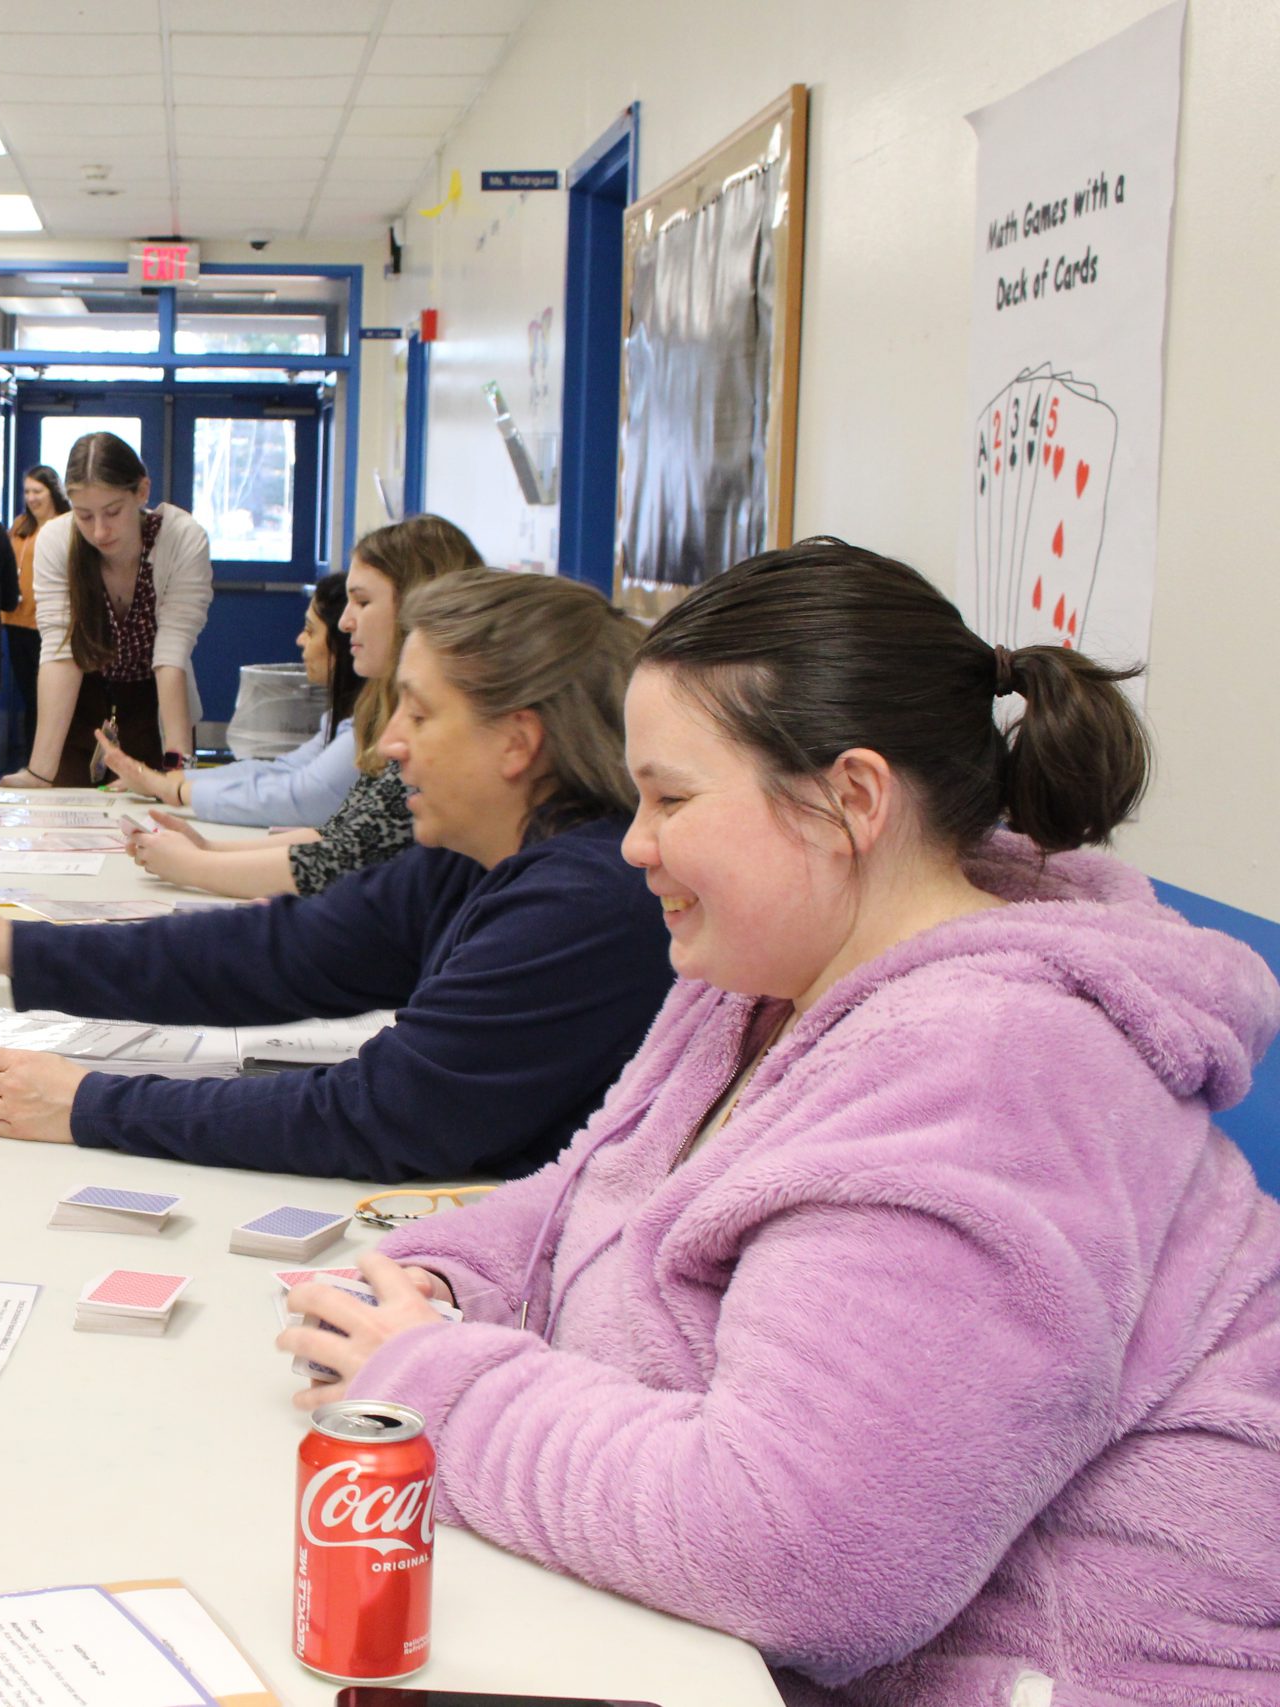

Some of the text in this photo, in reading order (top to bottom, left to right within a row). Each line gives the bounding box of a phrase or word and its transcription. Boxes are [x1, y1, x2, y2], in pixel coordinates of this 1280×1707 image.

[987, 171, 1124, 253] Math Games with a
[142, 246, 190, 281] EXIT
[996, 244, 1098, 311] Deck of Cards
[977, 393, 1059, 468] A 2 3 4 5
[371, 1554, 430, 1573] ORIGINAL
[296, 1544, 308, 1658] RECYCLE ME
